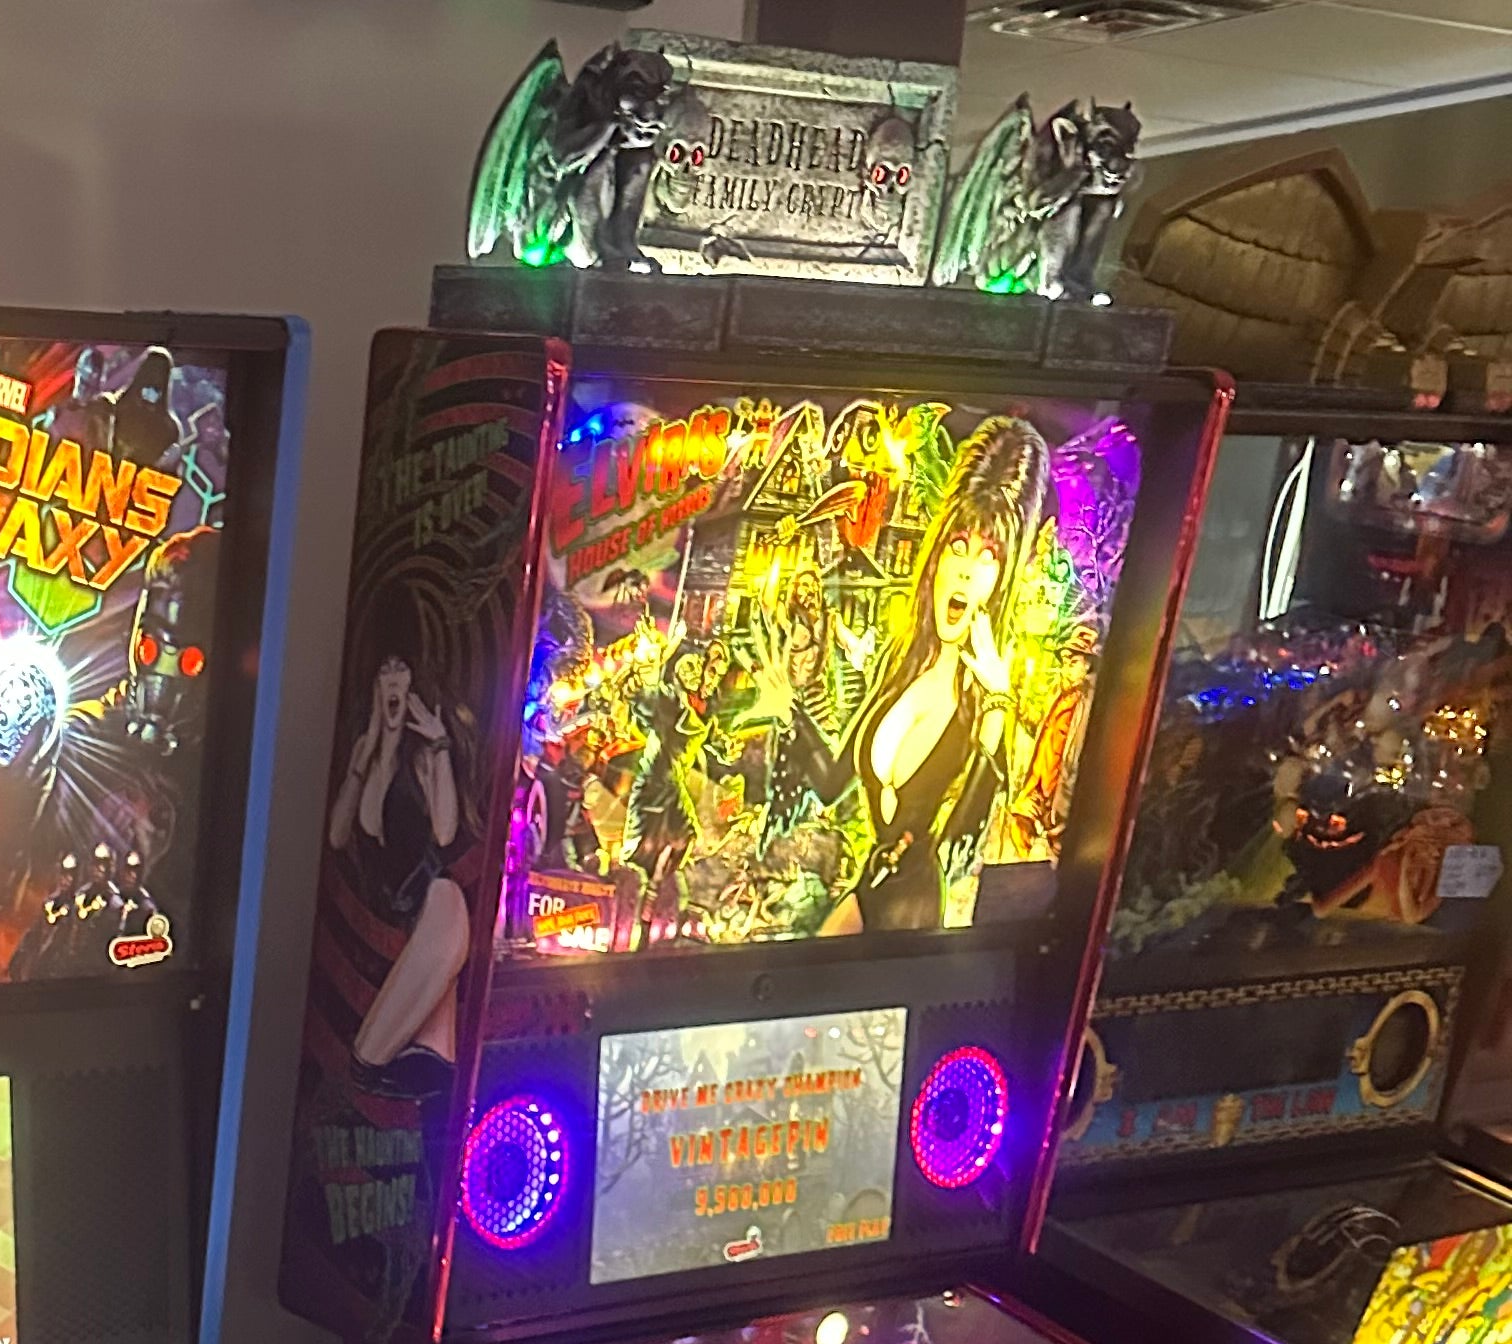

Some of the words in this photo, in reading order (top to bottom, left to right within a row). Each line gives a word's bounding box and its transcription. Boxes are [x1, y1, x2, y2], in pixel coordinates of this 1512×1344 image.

[708, 115, 865, 171] DEADHEAD
[693, 173, 780, 211] FAMILY
[528, 893, 565, 916] FOR
[558, 925, 609, 952] SALE
[784, 1067, 861, 1097] CHAMPION
[670, 1118, 828, 1168] VINTAGEPIN
